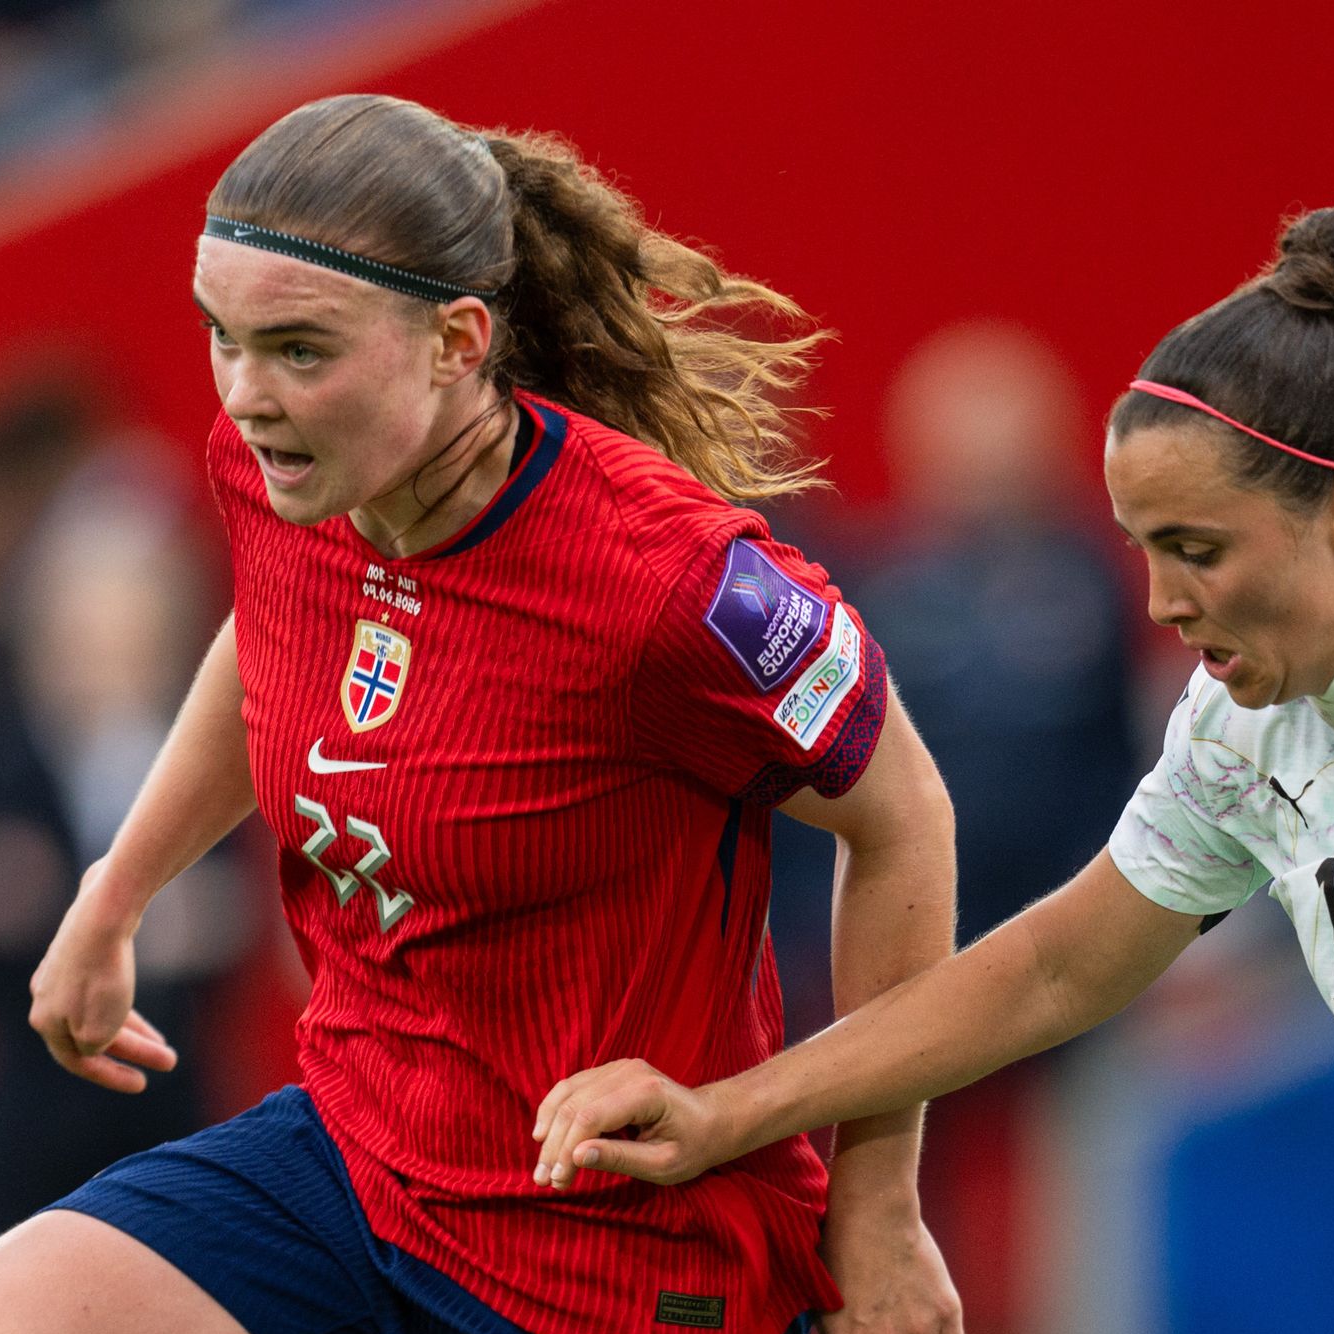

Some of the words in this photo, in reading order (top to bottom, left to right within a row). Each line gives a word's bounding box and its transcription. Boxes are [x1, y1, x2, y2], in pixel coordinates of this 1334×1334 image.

[366, 563, 386, 582] NOR
[397, 574, 418, 593] AUT
[756, 590, 801, 668] EUROPEAN
[763, 597, 813, 676] QUALIFIERS
[778, 692, 802, 723] UEFA
[786, 616, 853, 735] FOUNDATION
[294, 793, 415, 935] 22
